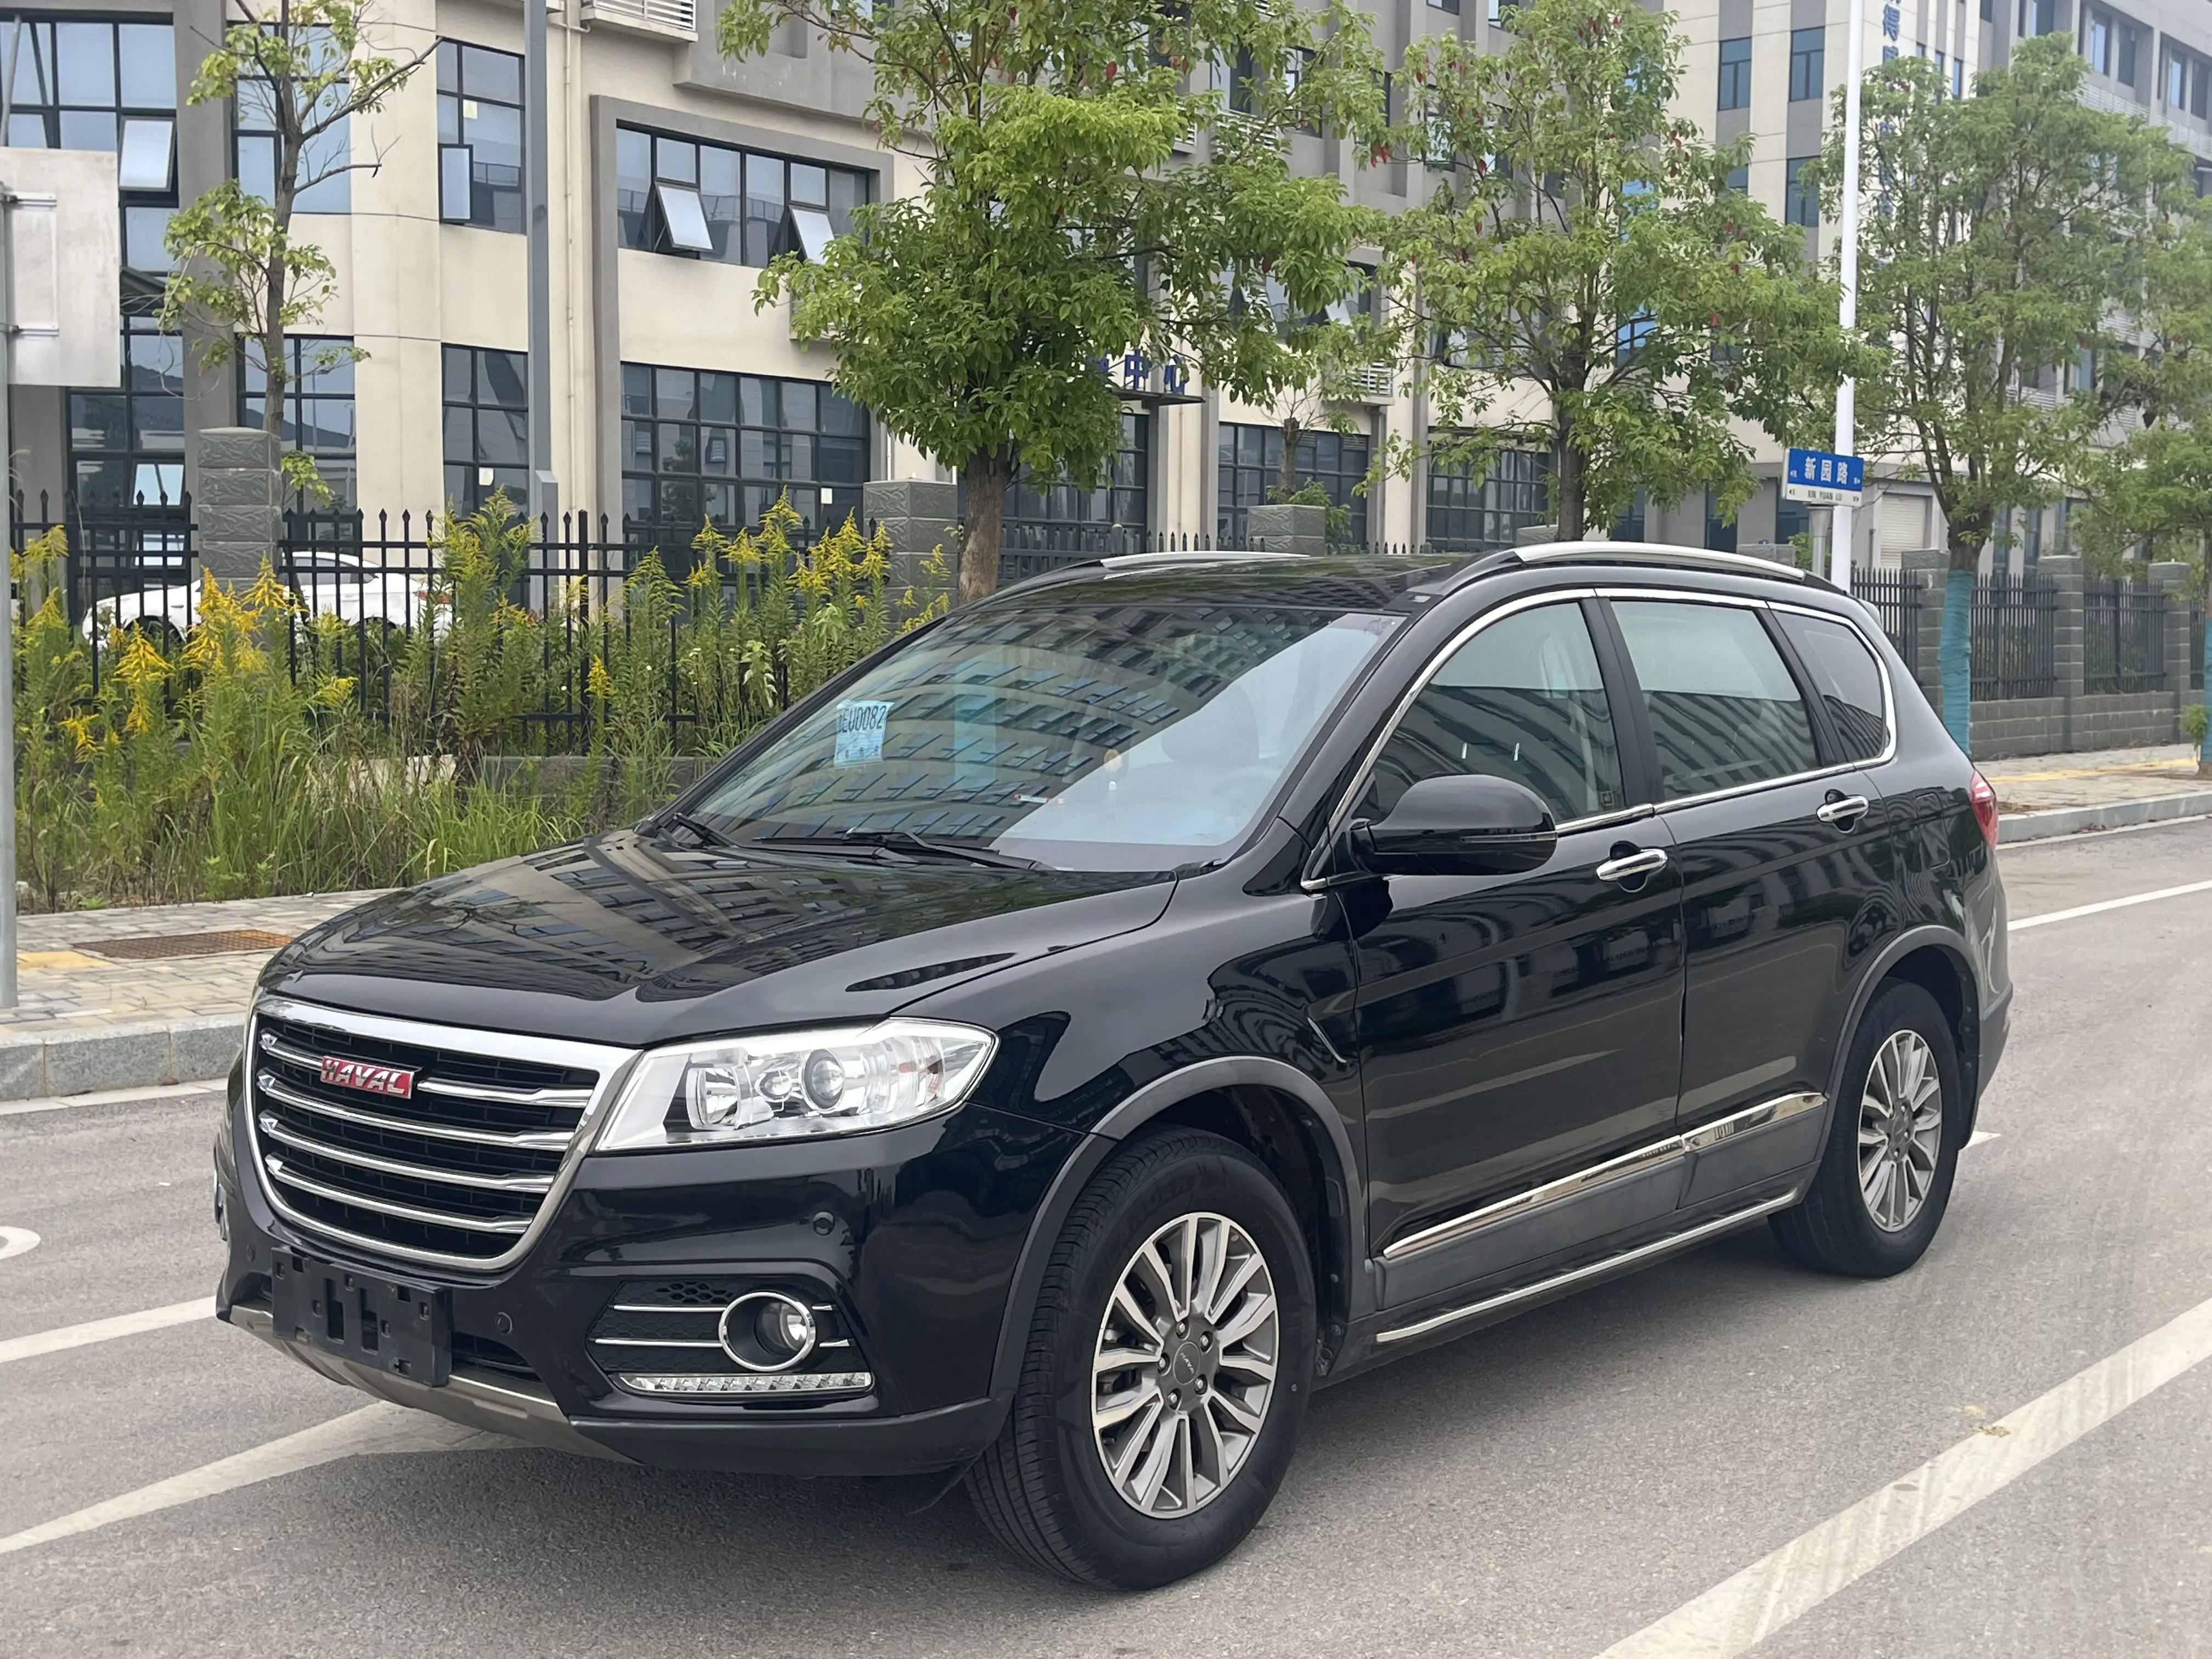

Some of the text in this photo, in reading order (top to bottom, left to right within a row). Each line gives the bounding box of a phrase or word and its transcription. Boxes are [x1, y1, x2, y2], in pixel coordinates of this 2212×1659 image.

[1804, 456, 1848, 485] 新园路
[1807, 490, 1816, 499] XIN
[1819, 492, 1833, 500] YUAN
[1835, 493, 1842, 501] LU
[320, 1060, 405, 1095] HAVAL
